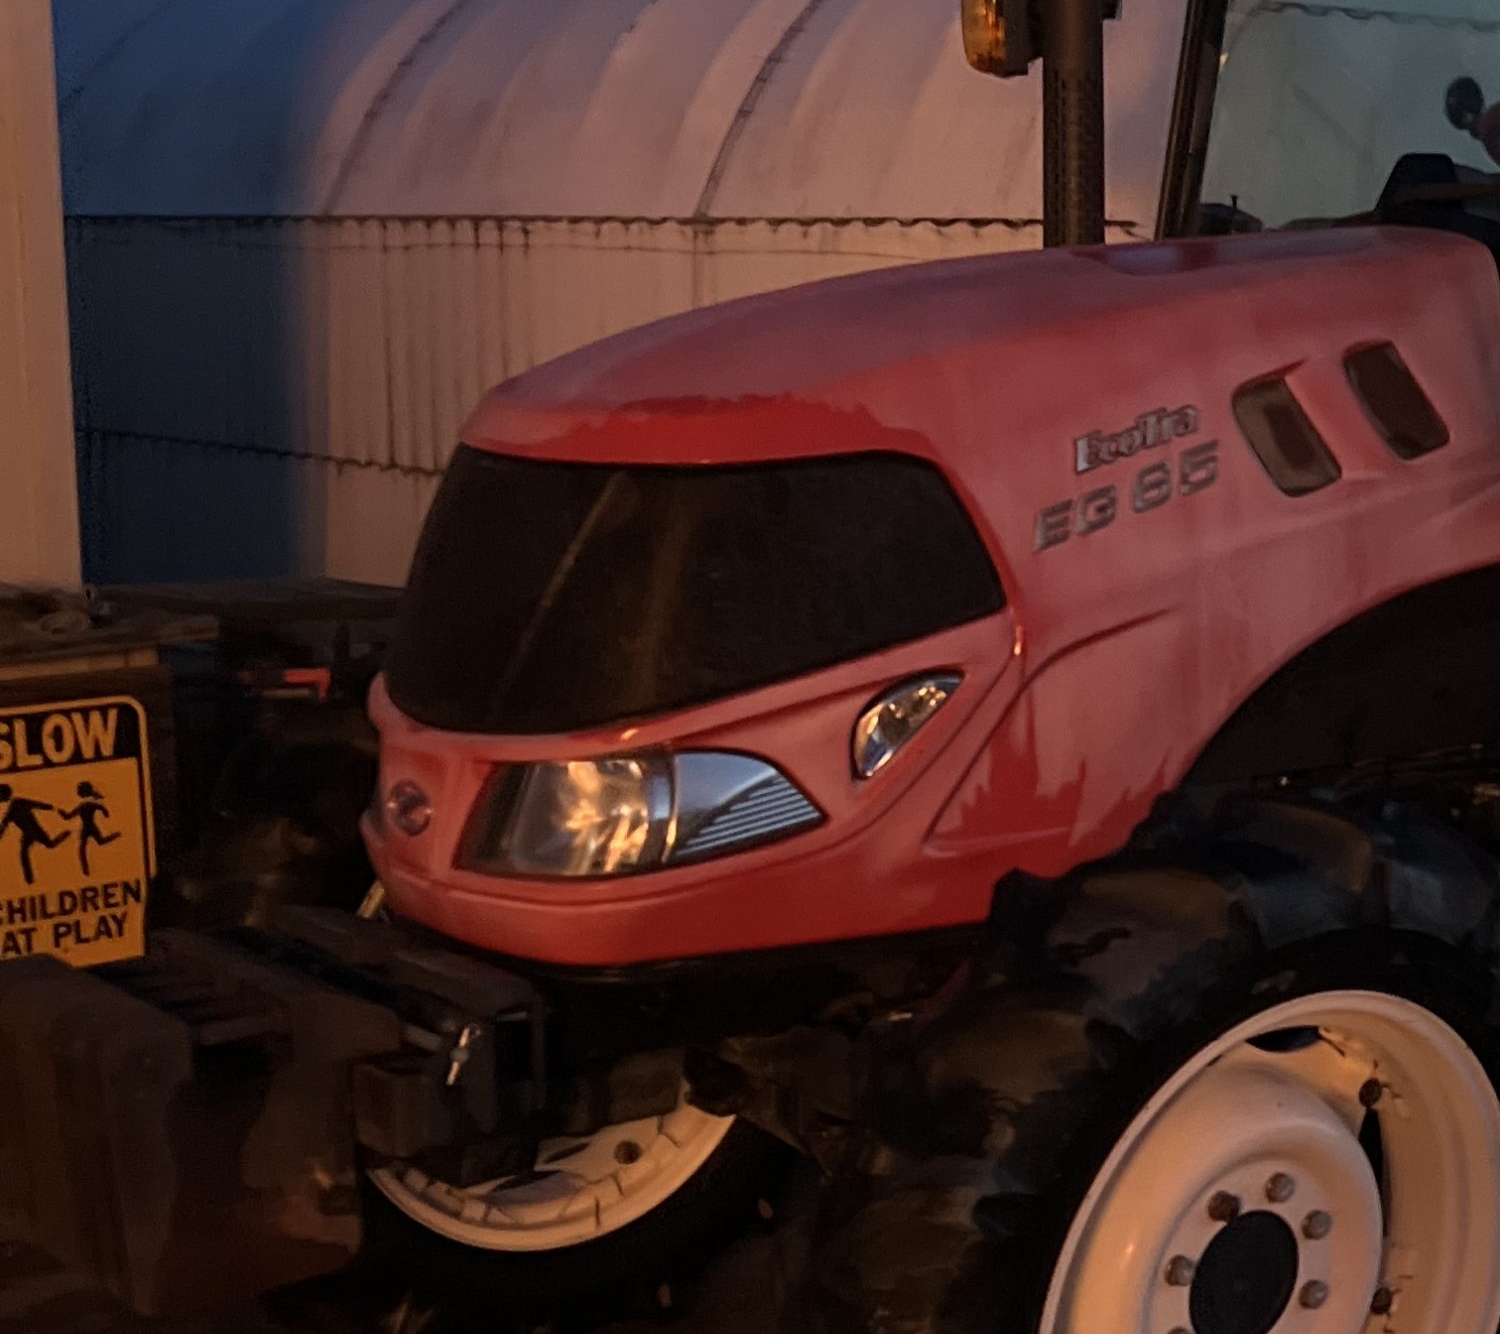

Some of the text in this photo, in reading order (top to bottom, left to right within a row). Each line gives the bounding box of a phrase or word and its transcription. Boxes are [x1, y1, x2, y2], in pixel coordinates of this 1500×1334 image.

[0, 878, 141, 925] HILDREN
[1, 912, 127, 954] AT PLAY
